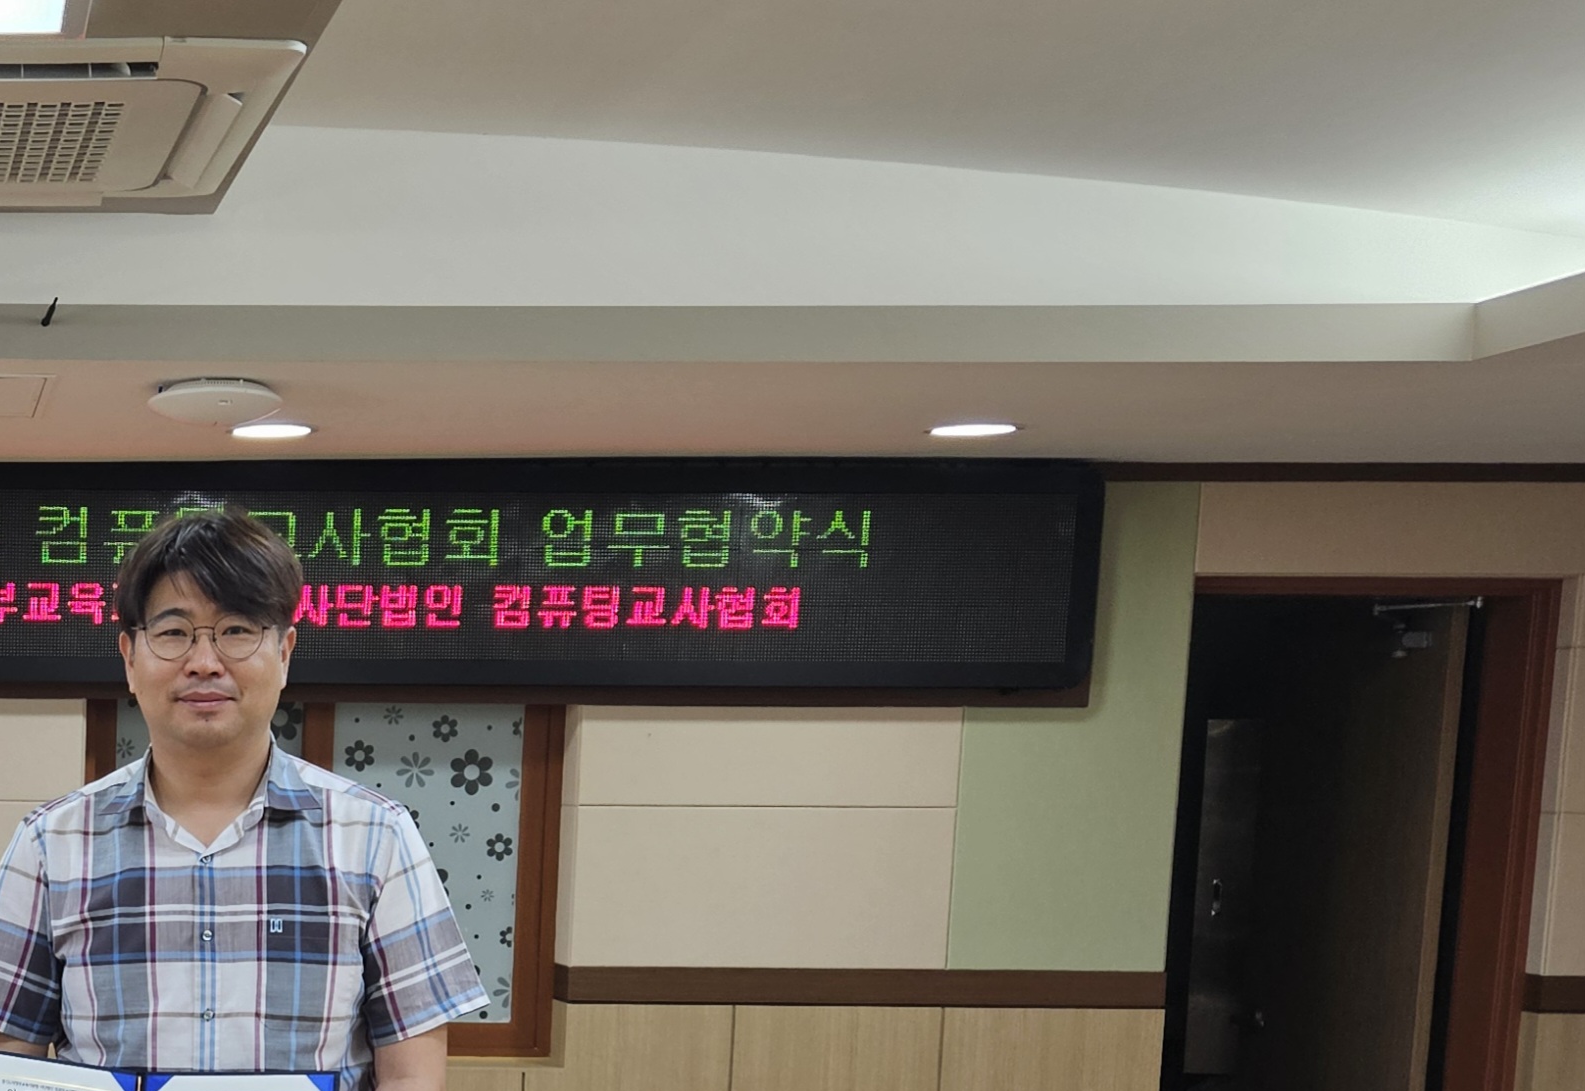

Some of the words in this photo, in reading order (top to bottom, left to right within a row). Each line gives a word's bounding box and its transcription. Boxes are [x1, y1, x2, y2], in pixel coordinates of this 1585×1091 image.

[36, 505, 500, 567] 컴퓨사협회
[540, 509, 872, 568] 업무협약식
[292, 583, 464, 628] 사단법인
[492, 584, 801, 630] 컴퓨팅교사협회
